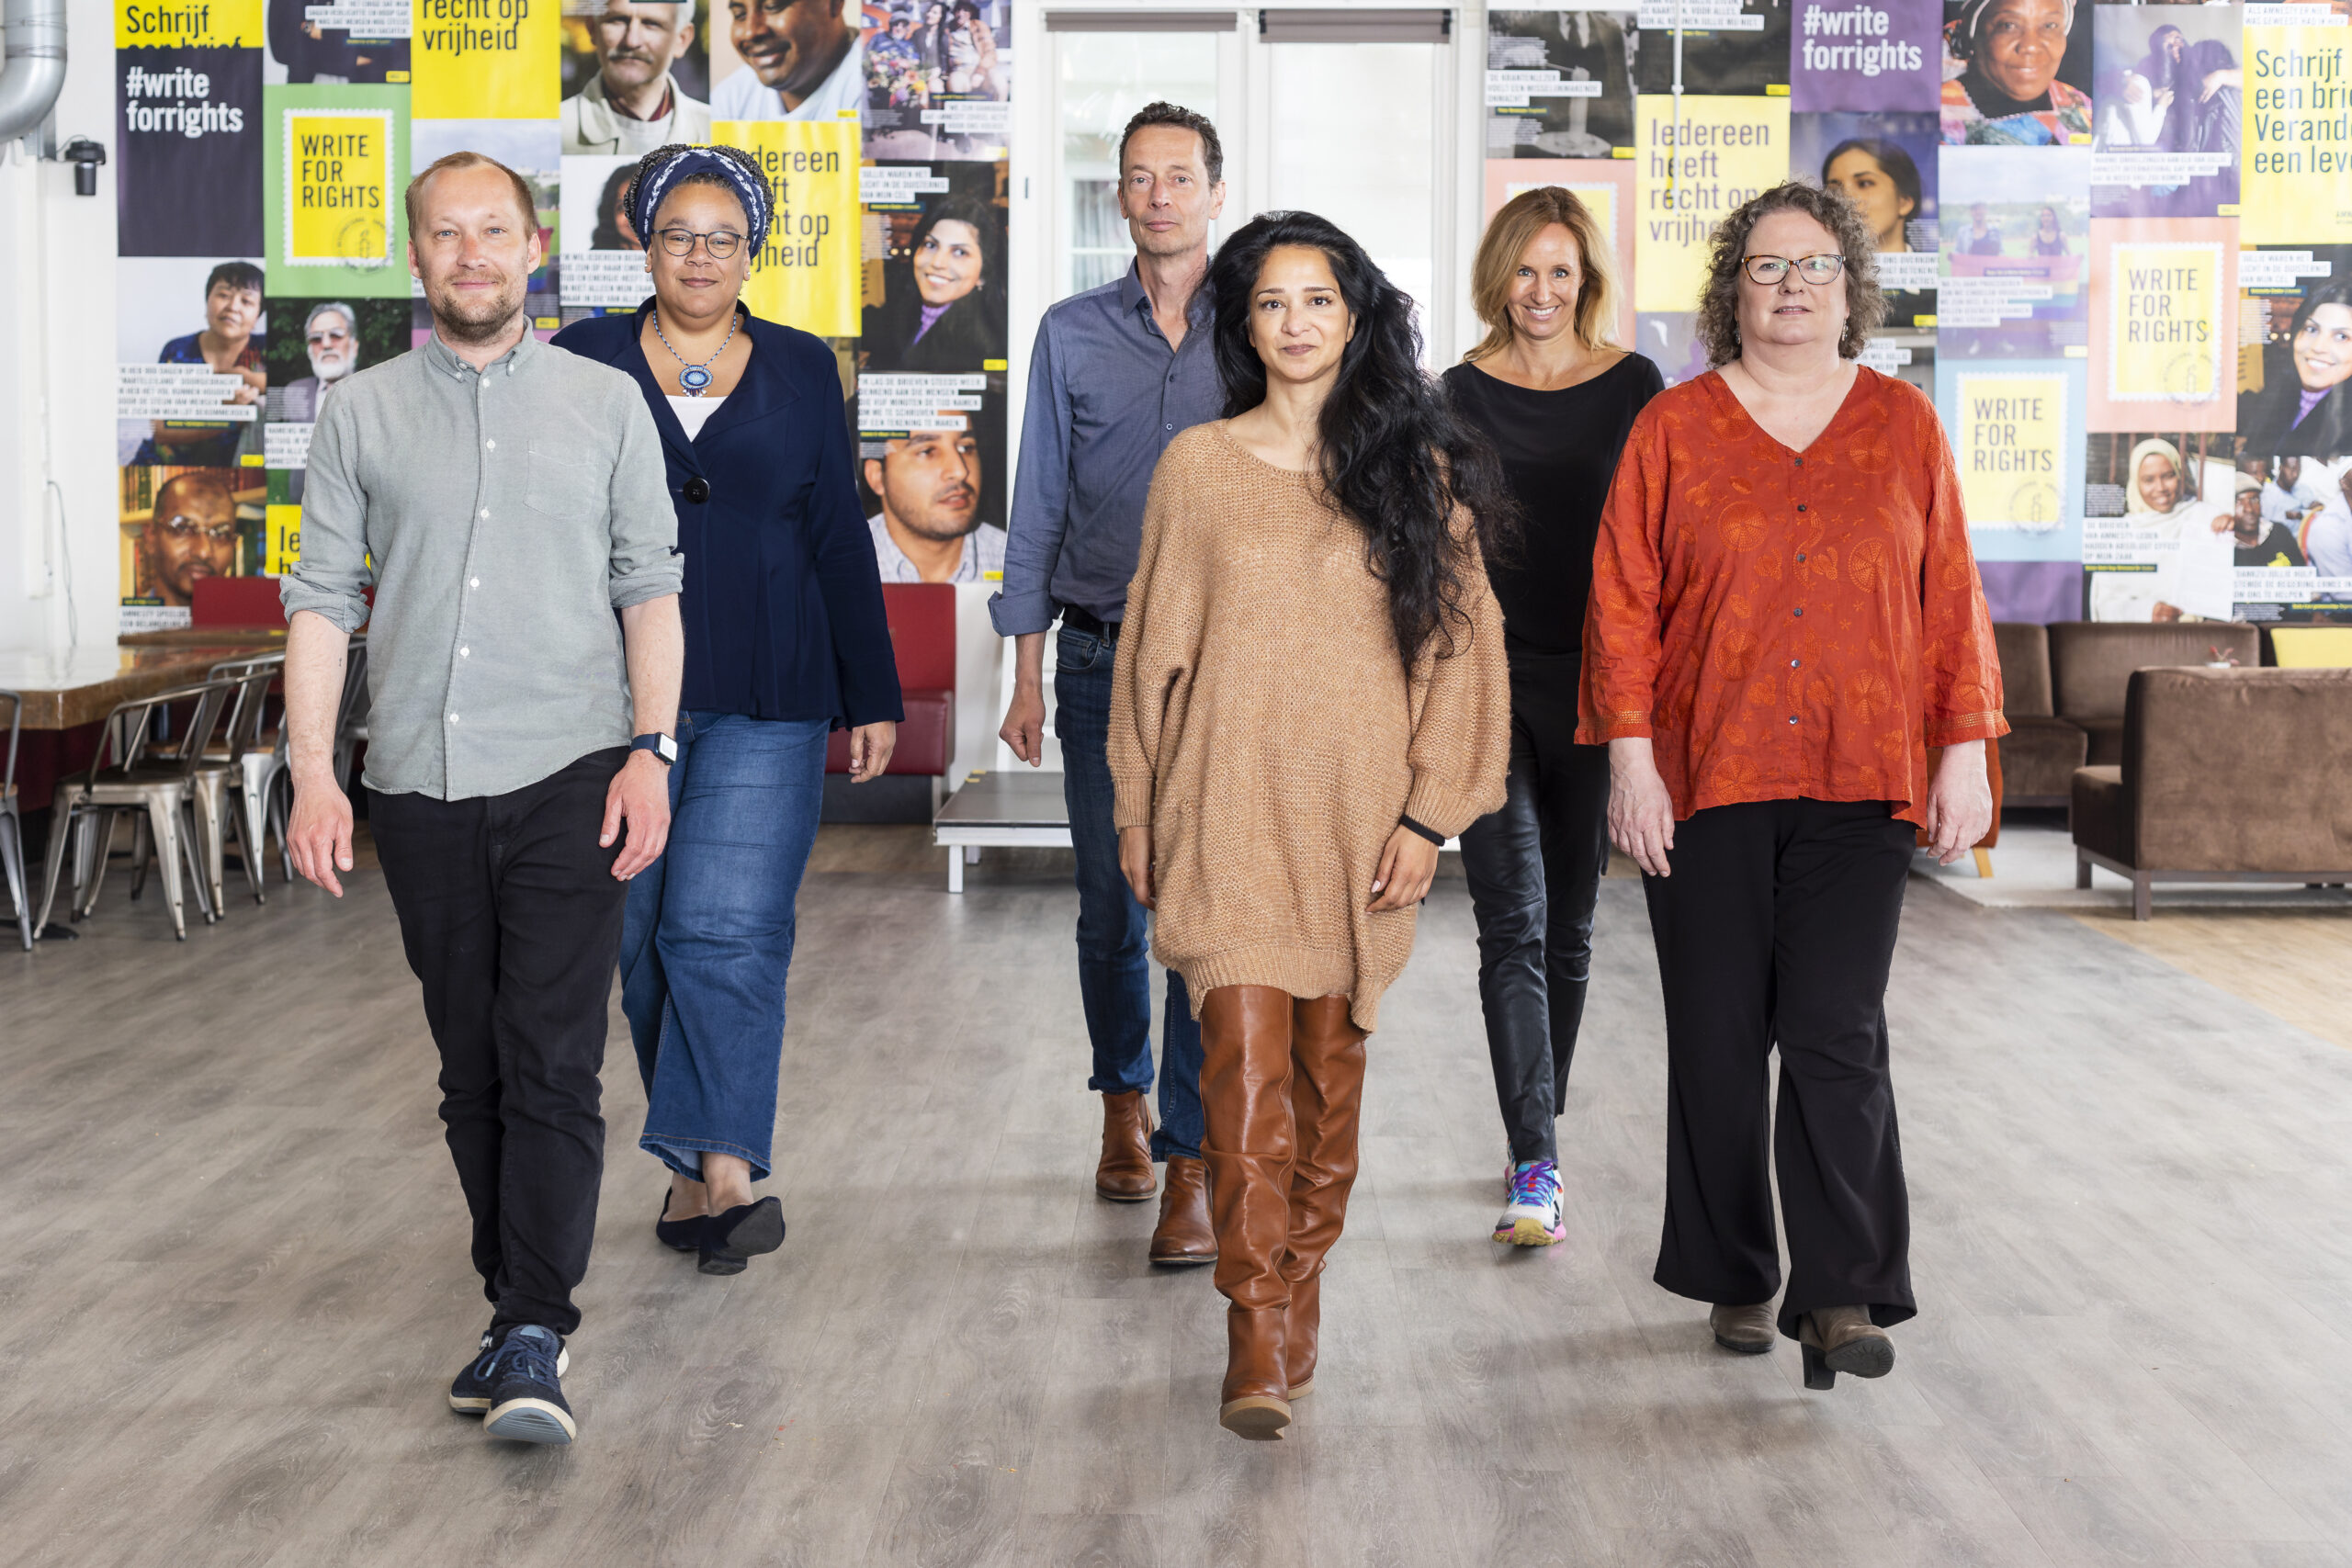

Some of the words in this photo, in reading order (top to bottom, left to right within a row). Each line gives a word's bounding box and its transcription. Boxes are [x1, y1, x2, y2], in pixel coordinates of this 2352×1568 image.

[127, 5, 209, 39] Schrijf
[499, 0, 527, 24] op
[1803, 5, 1889, 36] #write
[423, 23, 517, 56] vrijheid
[1803, 39, 1923, 76] forrights
[2256, 49, 2343, 83] Schrijf
[125, 65, 210, 98] #write
[2256, 88, 2303, 109] een
[2312, 81, 2352, 109] bri
[125, 100, 244, 139] forrights
[1652, 118, 1770, 146] Iedereen
[2255, 113, 2352, 141] Verand
[301, 134, 369, 157] WRITE
[751, 144, 840, 173] dereen
[2255, 152, 2301, 174] een
[2311, 145, 2352, 174] lev
[302, 160, 343, 182] FOR
[1651, 150, 1718, 178] heeft
[302, 186, 379, 209] RIGHTS
[1651, 182, 1719, 209] recht
[800, 213, 829, 241] op
[1650, 214, 1720, 248] vrijh
[2129, 269, 2199, 291] WRITE
[2129, 295, 2171, 317] FOR
[2129, 321, 2210, 343] RIGHTS
[1974, 399, 2043, 421] WRITE
[1974, 424, 2016, 446] FOR
[1974, 449, 2052, 472] RIGHTS
